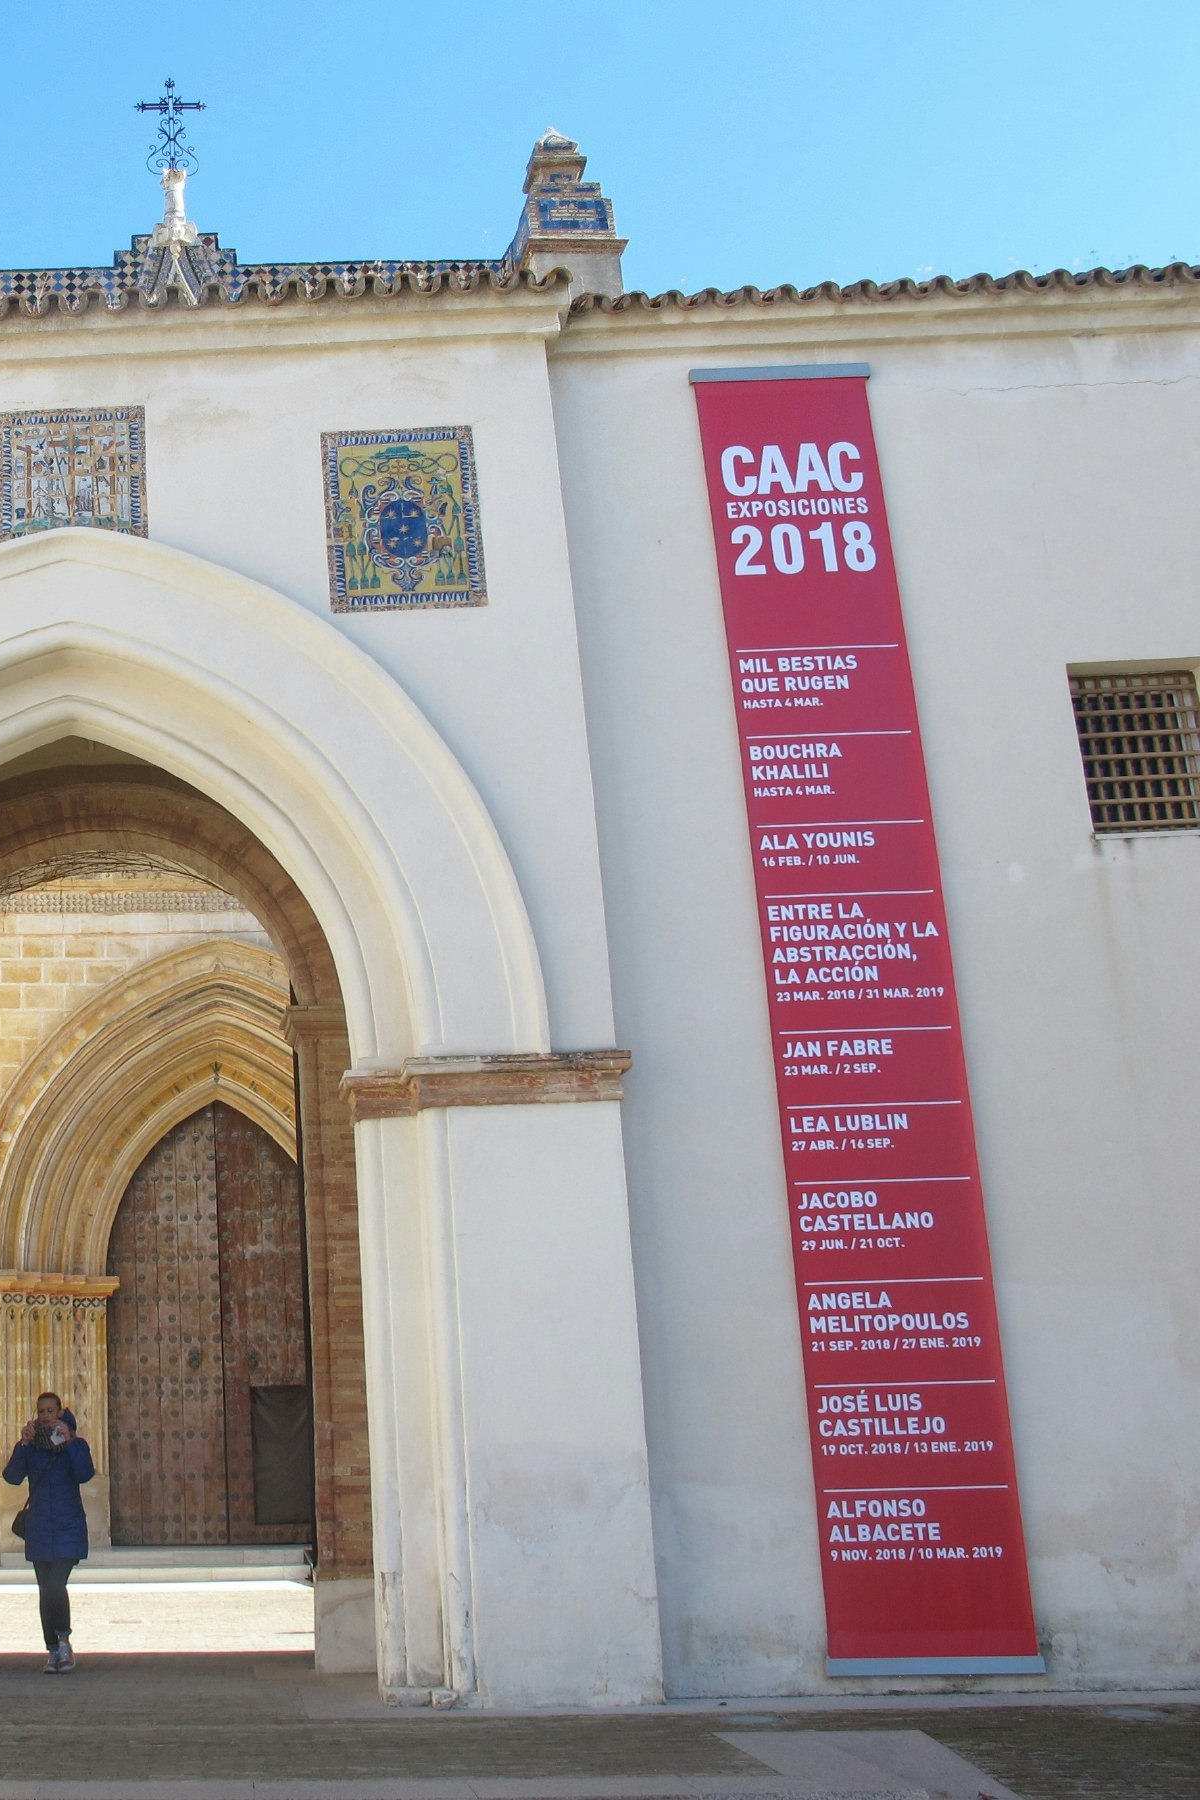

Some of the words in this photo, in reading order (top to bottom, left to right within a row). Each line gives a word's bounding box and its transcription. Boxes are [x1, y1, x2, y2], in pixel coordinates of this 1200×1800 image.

[721, 442, 863, 496] CAAC
[727, 497, 868, 518] EXPOSICIONES
[731, 521, 876, 575] 2018
[739, 658, 773, 673] MIL
[778, 655, 857, 671] BESTIAS
[742, 678, 779, 692] QUE
[784, 675, 849, 691] RUGEN
[743, 699, 782, 709] HASTA
[785, 698, 792, 706] 4
[794, 697, 823, 706] MAR.
[750, 743, 842, 760] BOUCHRA
[752, 763, 828, 780] KHALILI
[754, 787, 793, 797] HASTA
[796, 786, 803, 795] 4
[805, 785, 835, 795] MAR.
[760, 834, 799, 850] ALA
[802, 831, 874, 848] YOUNIS
[762, 857, 775, 866] 16
[779, 856, 805, 866] FEB.
[808, 855, 813, 866] /
[817, 855, 830, 864] 10
[833, 854, 859, 864] JUN.
[768, 904, 833, 921] ENTRE
[838, 903, 864, 918] LA
[770, 919, 890, 942] FIGURACIÓN
[894, 923, 906, 937] Y
[912, 922, 938, 937] LA
[773, 939, 916, 963] ABSTRACCIÓN,
[775, 969, 801, 984] LA
[805, 961, 878, 983] ACCIÓN
[777, 992, 790, 1001] 23
[793, 991, 824, 1001] MAR.
[827, 990, 855, 999] 2018
[858, 989, 863, 999] /
[866, 989, 879, 998] 31
[883, 988, 913, 998] MAR.
[916, 987, 943, 997] 2019
[783, 1041, 821, 1058] JAN
[827, 1039, 893, 1056] FABRE
[784, 1066, 798, 1075] 23
[801, 1065, 832, 1075] MAR.
[836, 1063, 840, 1074] /
[844, 1064, 850, 1073] 2
[853, 1063, 880, 1073] SEP.
[790, 1116, 830, 1133] LEA
[834, 1114, 908, 1131] LUBLIN
[792, 1141, 806, 1151] 27
[809, 1140, 838, 1150] ABR.
[842, 1139, 846, 1150] /
[850, 1139, 864, 1148] 16
[867, 1138, 894, 1148] SEP.
[798, 1191, 877, 1209] JACOBO
[800, 1212, 933, 1232] CASTELLANO
[802, 1240, 816, 1250] 29
[820, 1239, 847, 1250] JUN.
[851, 1238, 856, 1249] /
[860, 1238, 872, 1248] 21
[877, 1238, 904, 1248] OCT.
[808, 1292, 892, 1310] ANGELA
[810, 1312, 968, 1333] MELITOPOULOS
[812, 1341, 825, 1351] 21
[829, 1340, 857, 1351] SEP.
[861, 1339, 890, 1350] 2018
[893, 1338, 898, 1350] /
[902, 1338, 916, 1349] 27
[920, 1338, 948, 1348] ENE.
[952, 1337, 981, 1347] 2019
[817, 1390, 869, 1413] JOSÉ
[875, 1393, 921, 1411] LUIS
[820, 1417, 945, 1437] CASTILLEJO
[822, 1445, 836, 1455] 19
[840, 1444, 868, 1455] OCT.
[871, 1443, 901, 1454] 2018
[905, 1442, 909, 1454] /
[914, 1442, 928, 1453] 13
[931, 1442, 961, 1452] ENE.
[964, 1441, 993, 1451] 2019
[827, 1499, 925, 1518] ALFONSO
[829, 1523, 940, 1542] ALBACETE
[831, 1550, 838, 1561] 9
[842, 1550, 872, 1561] NOV.
[876, 1549, 905, 1560] 2018
[909, 1548, 914, 1560] /
[918, 1548, 932, 1559] 10
[936, 1547, 969, 1558] MAR.
[972, 1547, 1002, 1558] 2019
